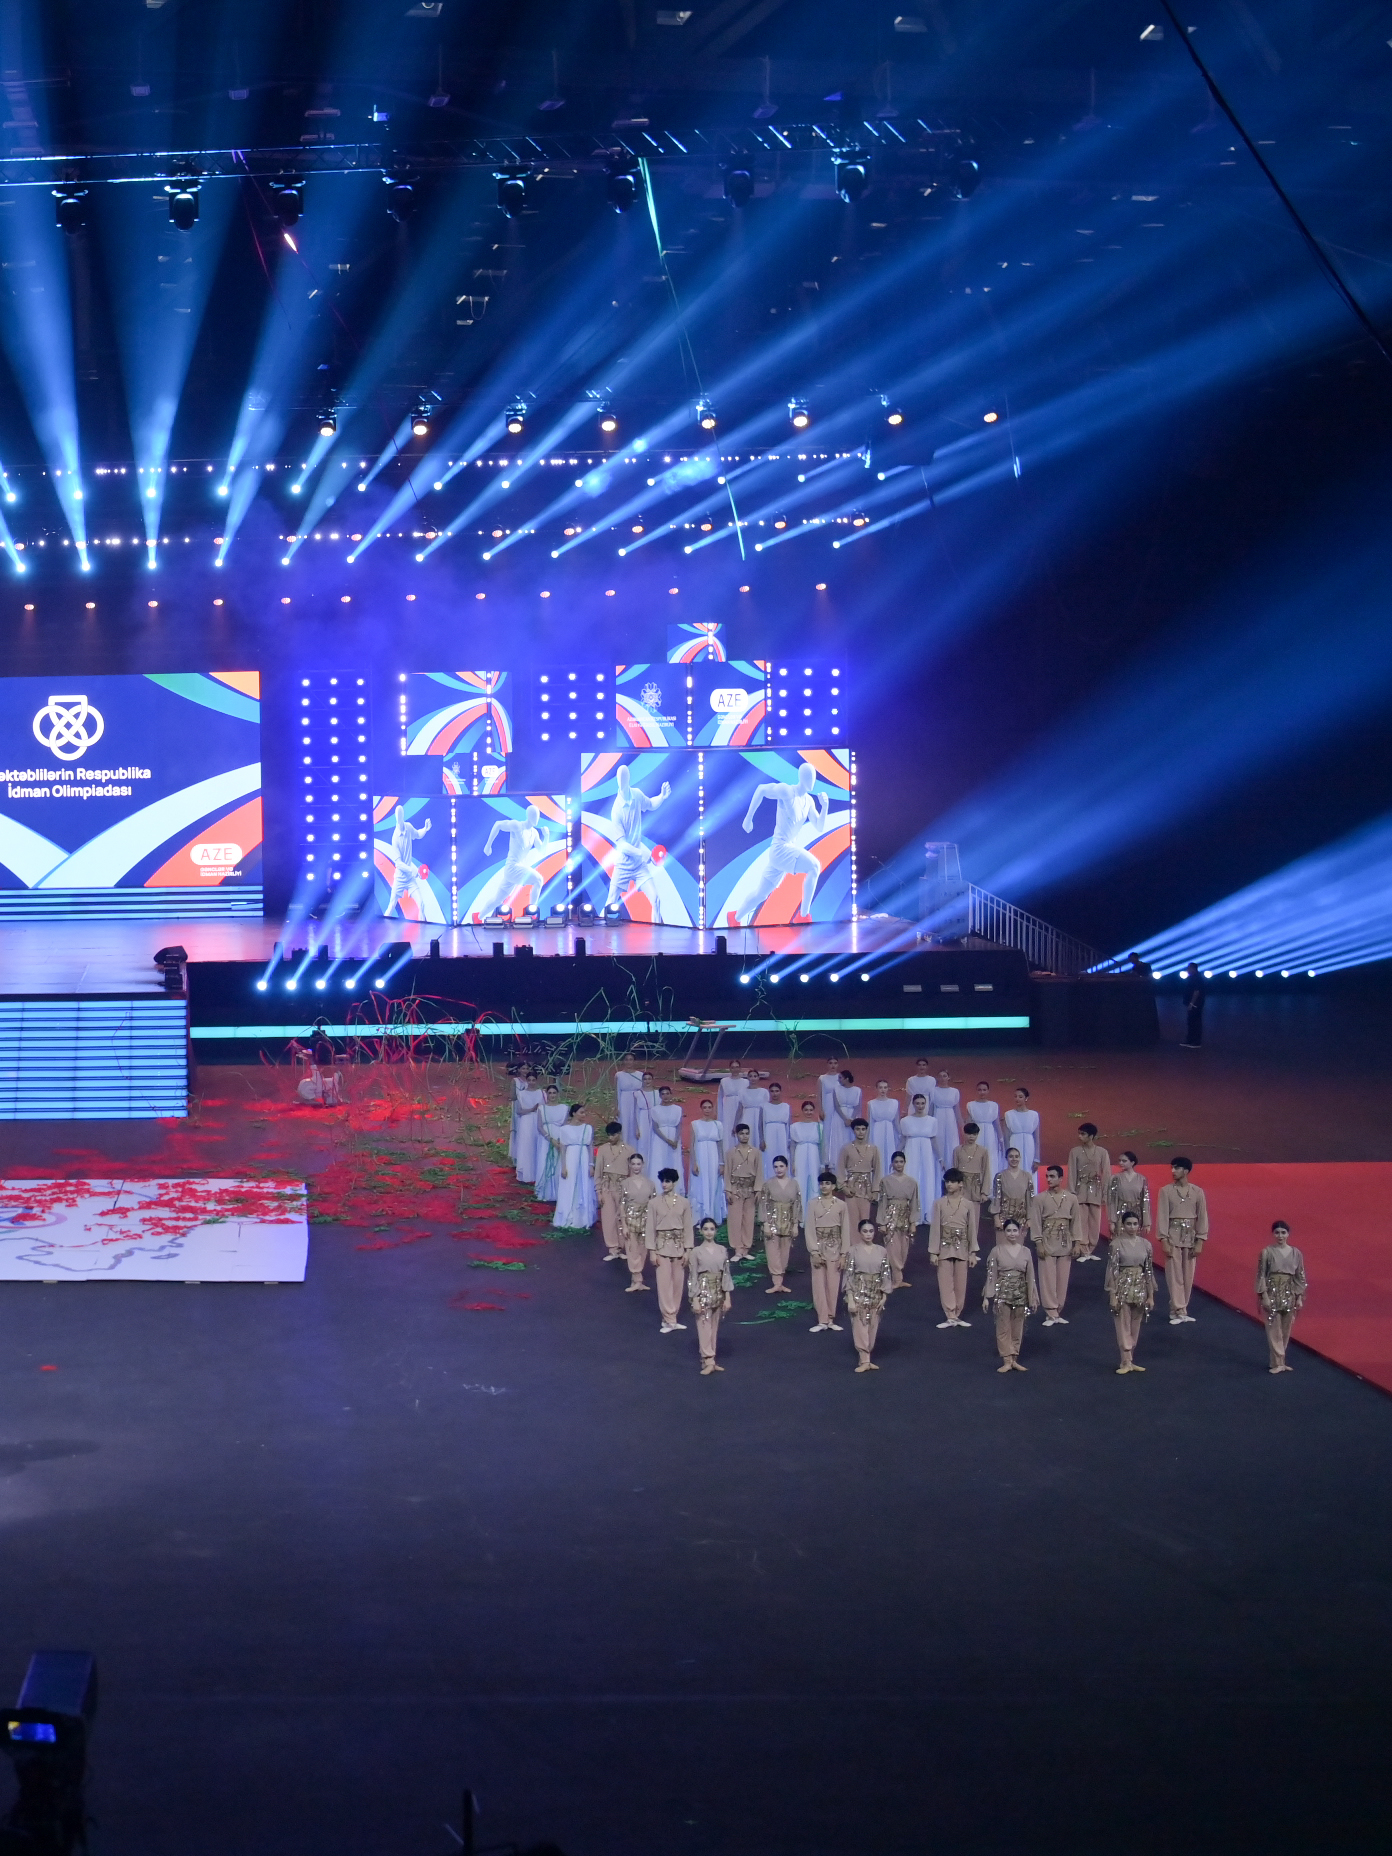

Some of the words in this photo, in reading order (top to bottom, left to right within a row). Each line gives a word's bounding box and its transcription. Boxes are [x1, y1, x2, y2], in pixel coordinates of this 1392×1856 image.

[717, 693, 742, 708] AZE
[76, 767, 151, 783] Respublika
[8, 783, 50, 798] İdman
[52, 784, 132, 800] Olimpiadası
[200, 847, 233, 861] AZE
